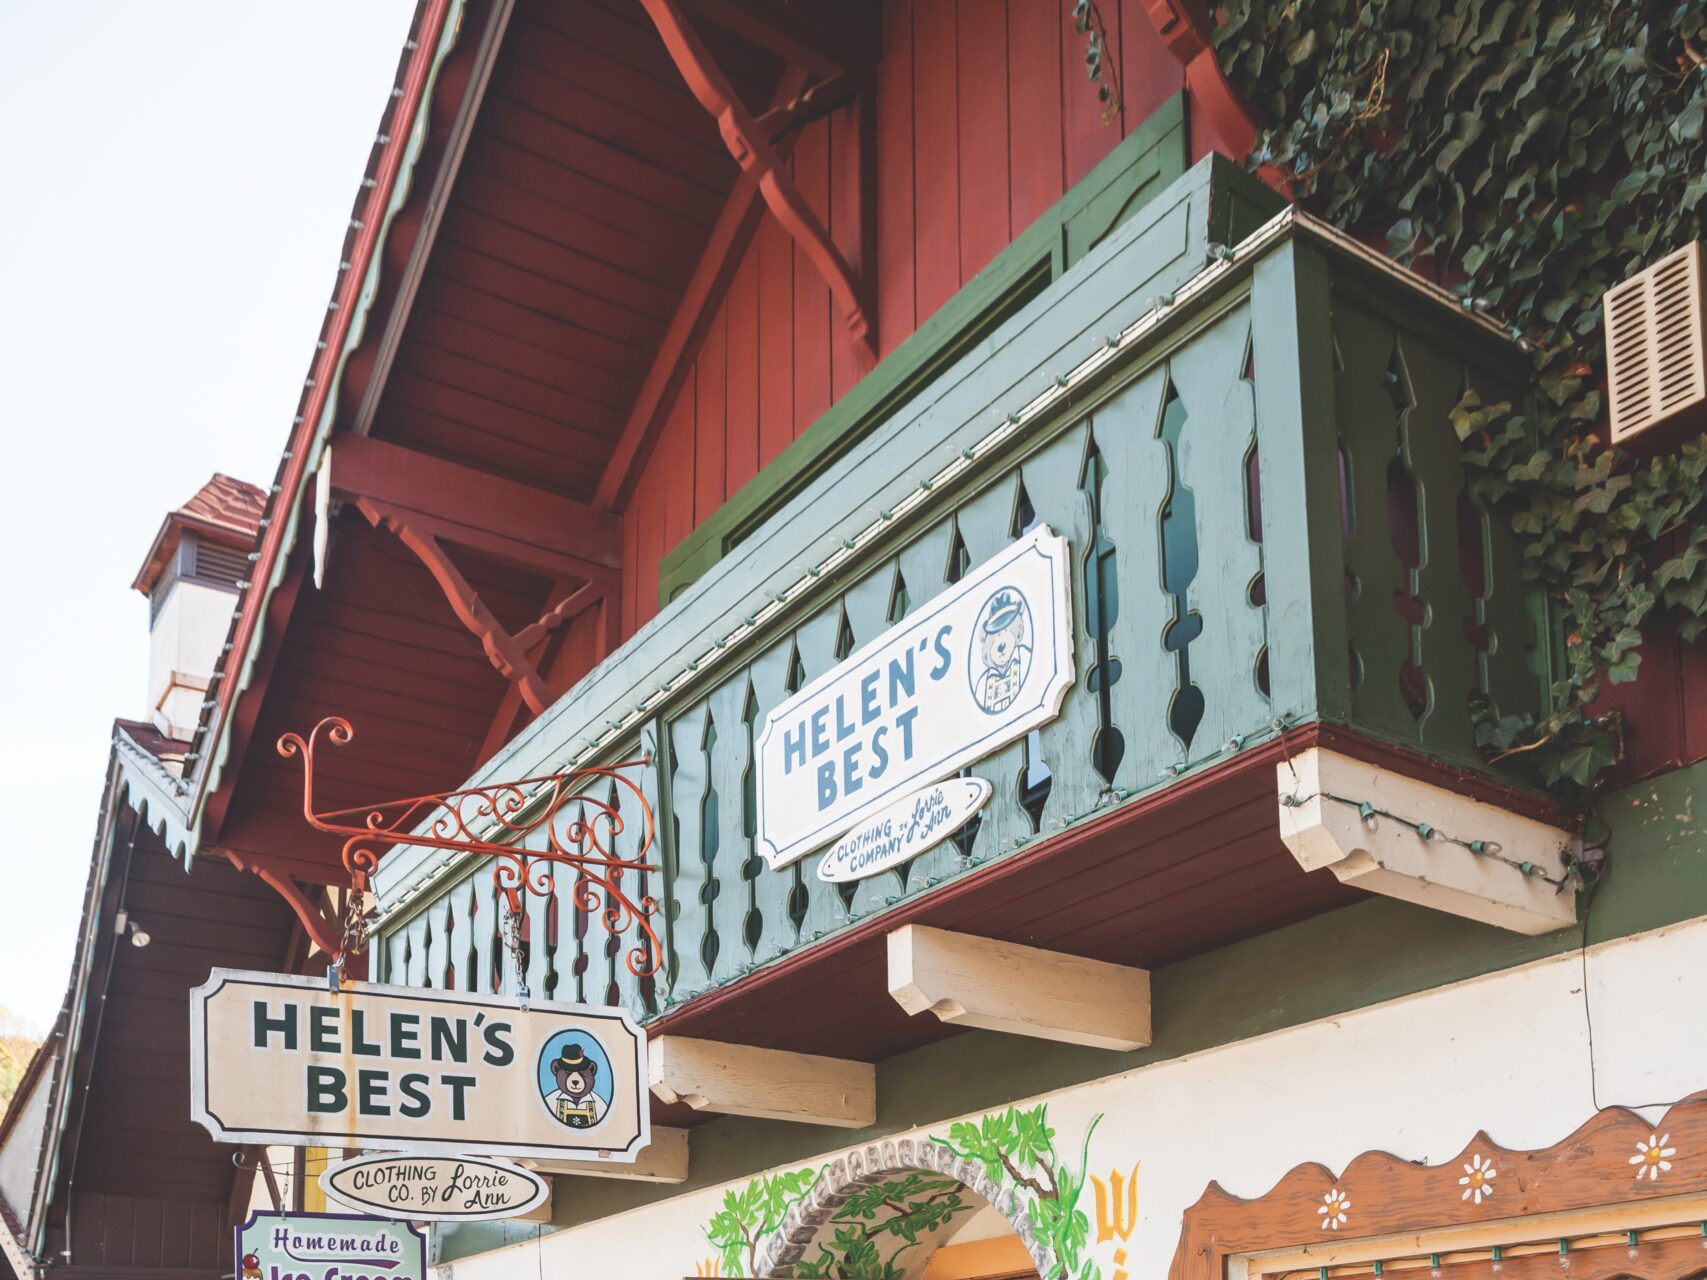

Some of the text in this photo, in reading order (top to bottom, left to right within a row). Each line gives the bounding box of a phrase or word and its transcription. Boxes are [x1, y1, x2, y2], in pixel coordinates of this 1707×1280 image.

[783, 624, 953, 776] HELEN'S
[817, 705, 919, 813] BEST
[837, 817, 893, 862] CLOTHING
[850, 804, 952, 873] COMPANY Ann
[252, 1000, 513, 1067] HELEN'S
[306, 1065, 477, 1121] BEST
[353, 1164, 509, 1202] CLOTHING Lorrie
[388, 1184, 511, 1209] CO. BY Ann
[273, 1228, 401, 1259] Homemade
